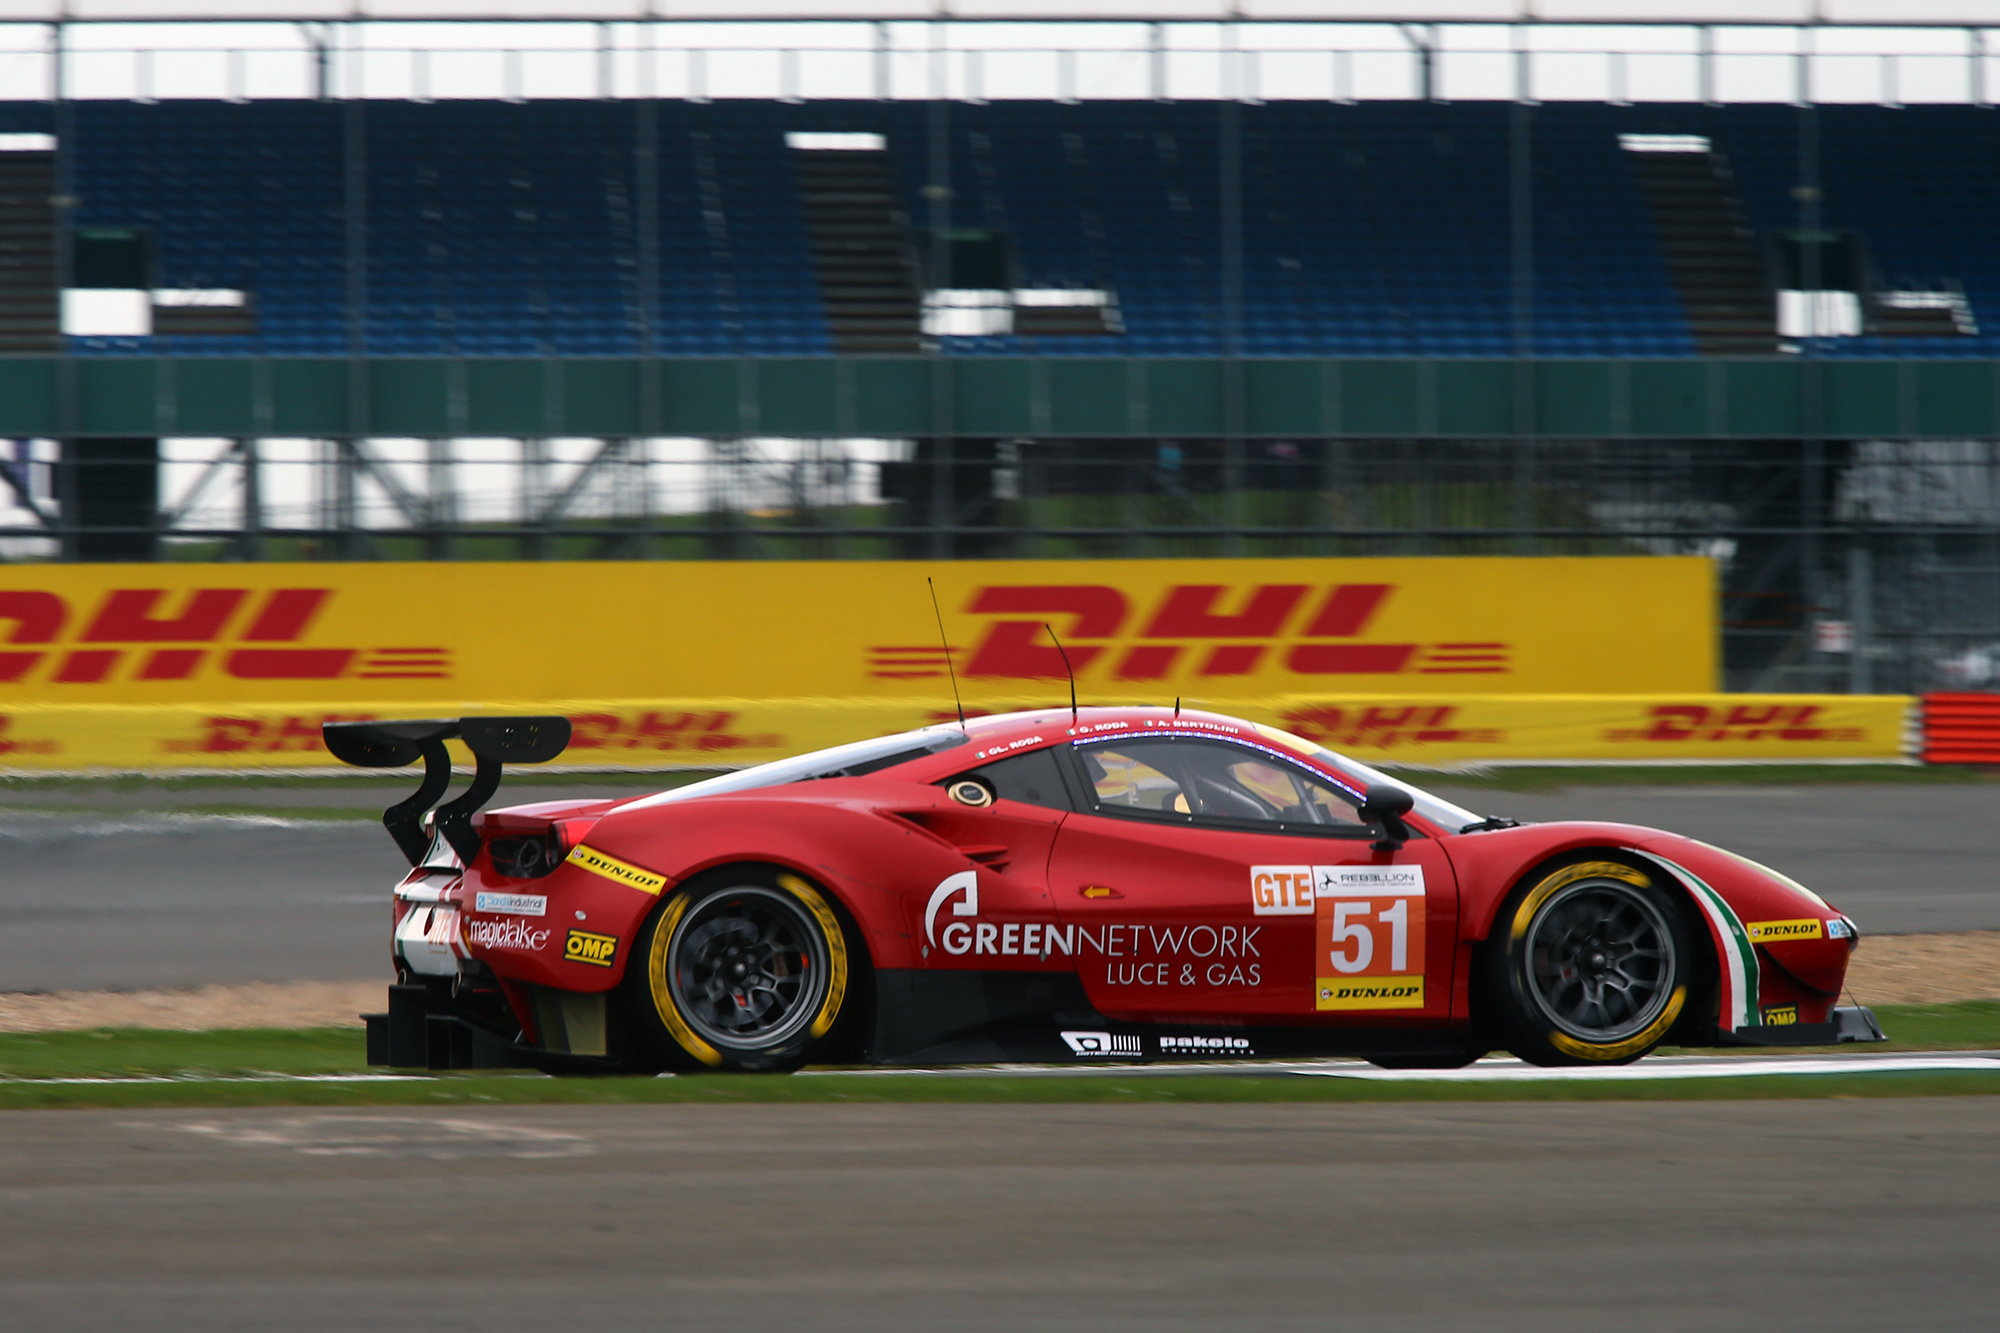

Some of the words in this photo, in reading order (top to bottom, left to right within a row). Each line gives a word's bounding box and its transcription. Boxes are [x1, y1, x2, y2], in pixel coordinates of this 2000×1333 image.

[962, 584, 1418, 680] DHL
[1079, 726, 1093, 734] G.
[1096, 721, 1129, 731] RODA
[1173, 721, 1239, 734] BERTOLINI
[1280, 706, 1460, 749] DHL
[1648, 705, 1824, 741] DHL
[1009, 735, 1043, 750] RODA
[587, 856, 660, 887] DUNLOP
[1253, 873, 1312, 908] GTE
[1330, 899, 1408, 974] 51
[1763, 924, 1818, 936] DUNLOP
[566, 935, 615, 961] OMP
[1107, 963, 1170, 985] LUCE
[1179, 963, 1197, 985] &
[1206, 963, 1262, 985] GAS
[1336, 987, 1420, 999] DUNLOP
[1766, 1011, 1798, 1026] OMP
[1159, 1036, 1250, 1049] pakelo
